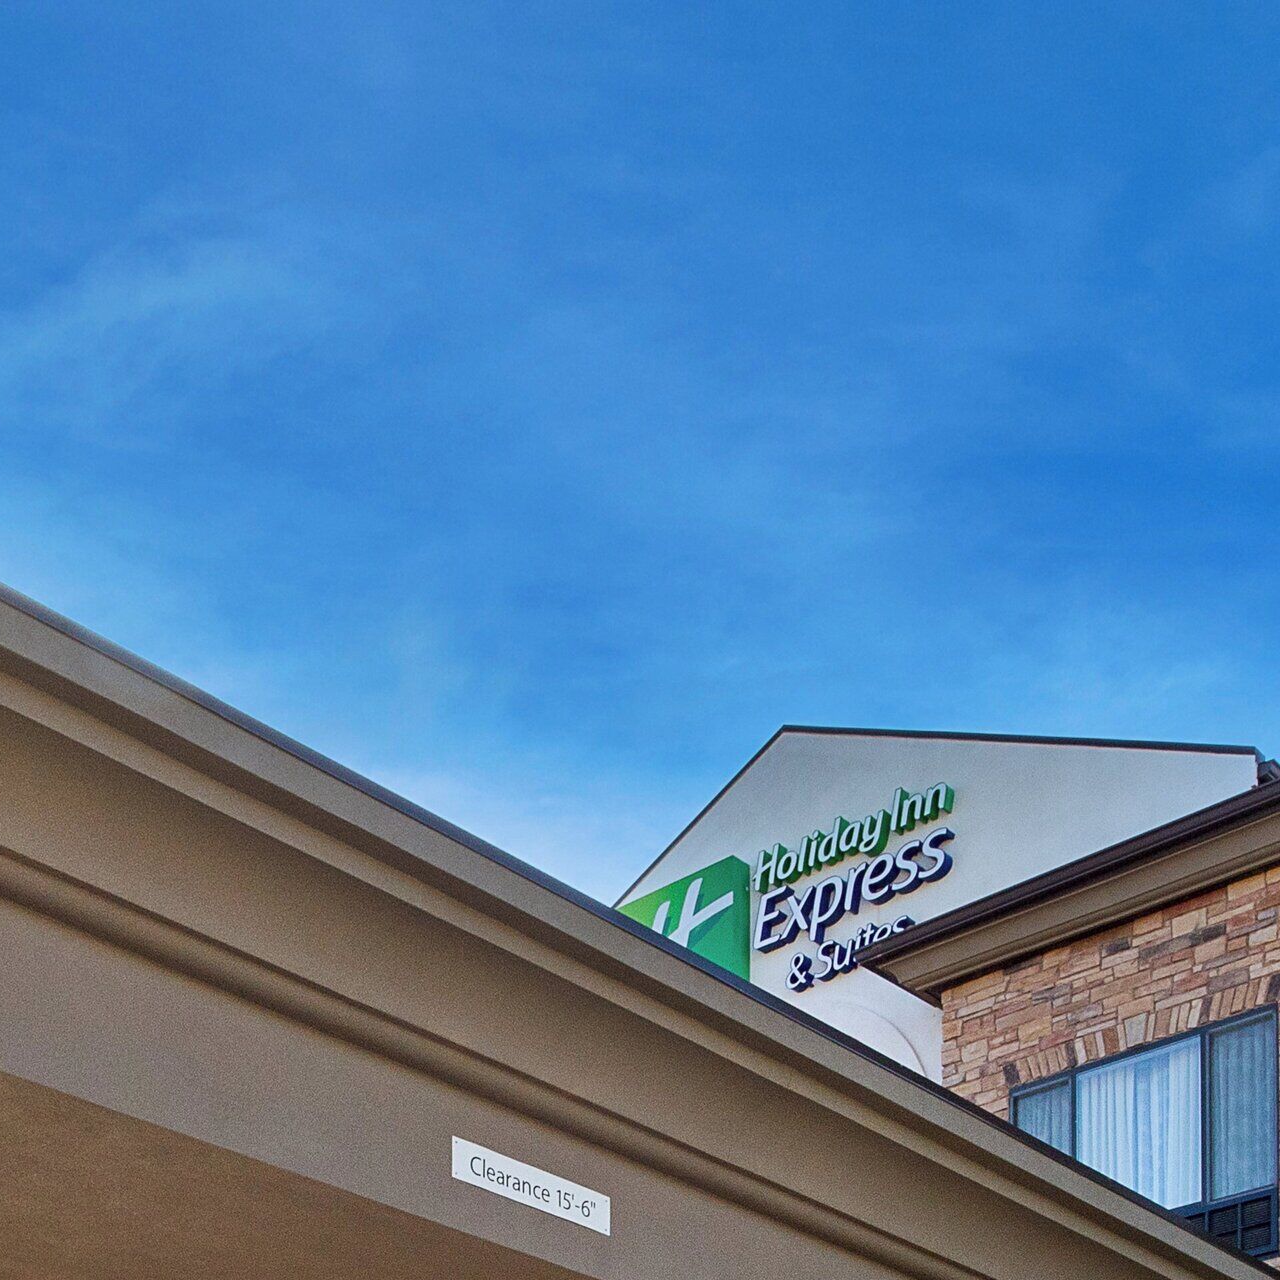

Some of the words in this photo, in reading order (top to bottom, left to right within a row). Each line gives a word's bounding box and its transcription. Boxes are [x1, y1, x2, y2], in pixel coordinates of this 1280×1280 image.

[753, 809, 888, 893] Holiday
[891, 782, 952, 834] Inn
[753, 827, 953, 951] Express
[786, 953, 811, 991] &
[470, 1156, 551, 1203] Clearance
[556, 1189, 597, 1218] 15'-6"
